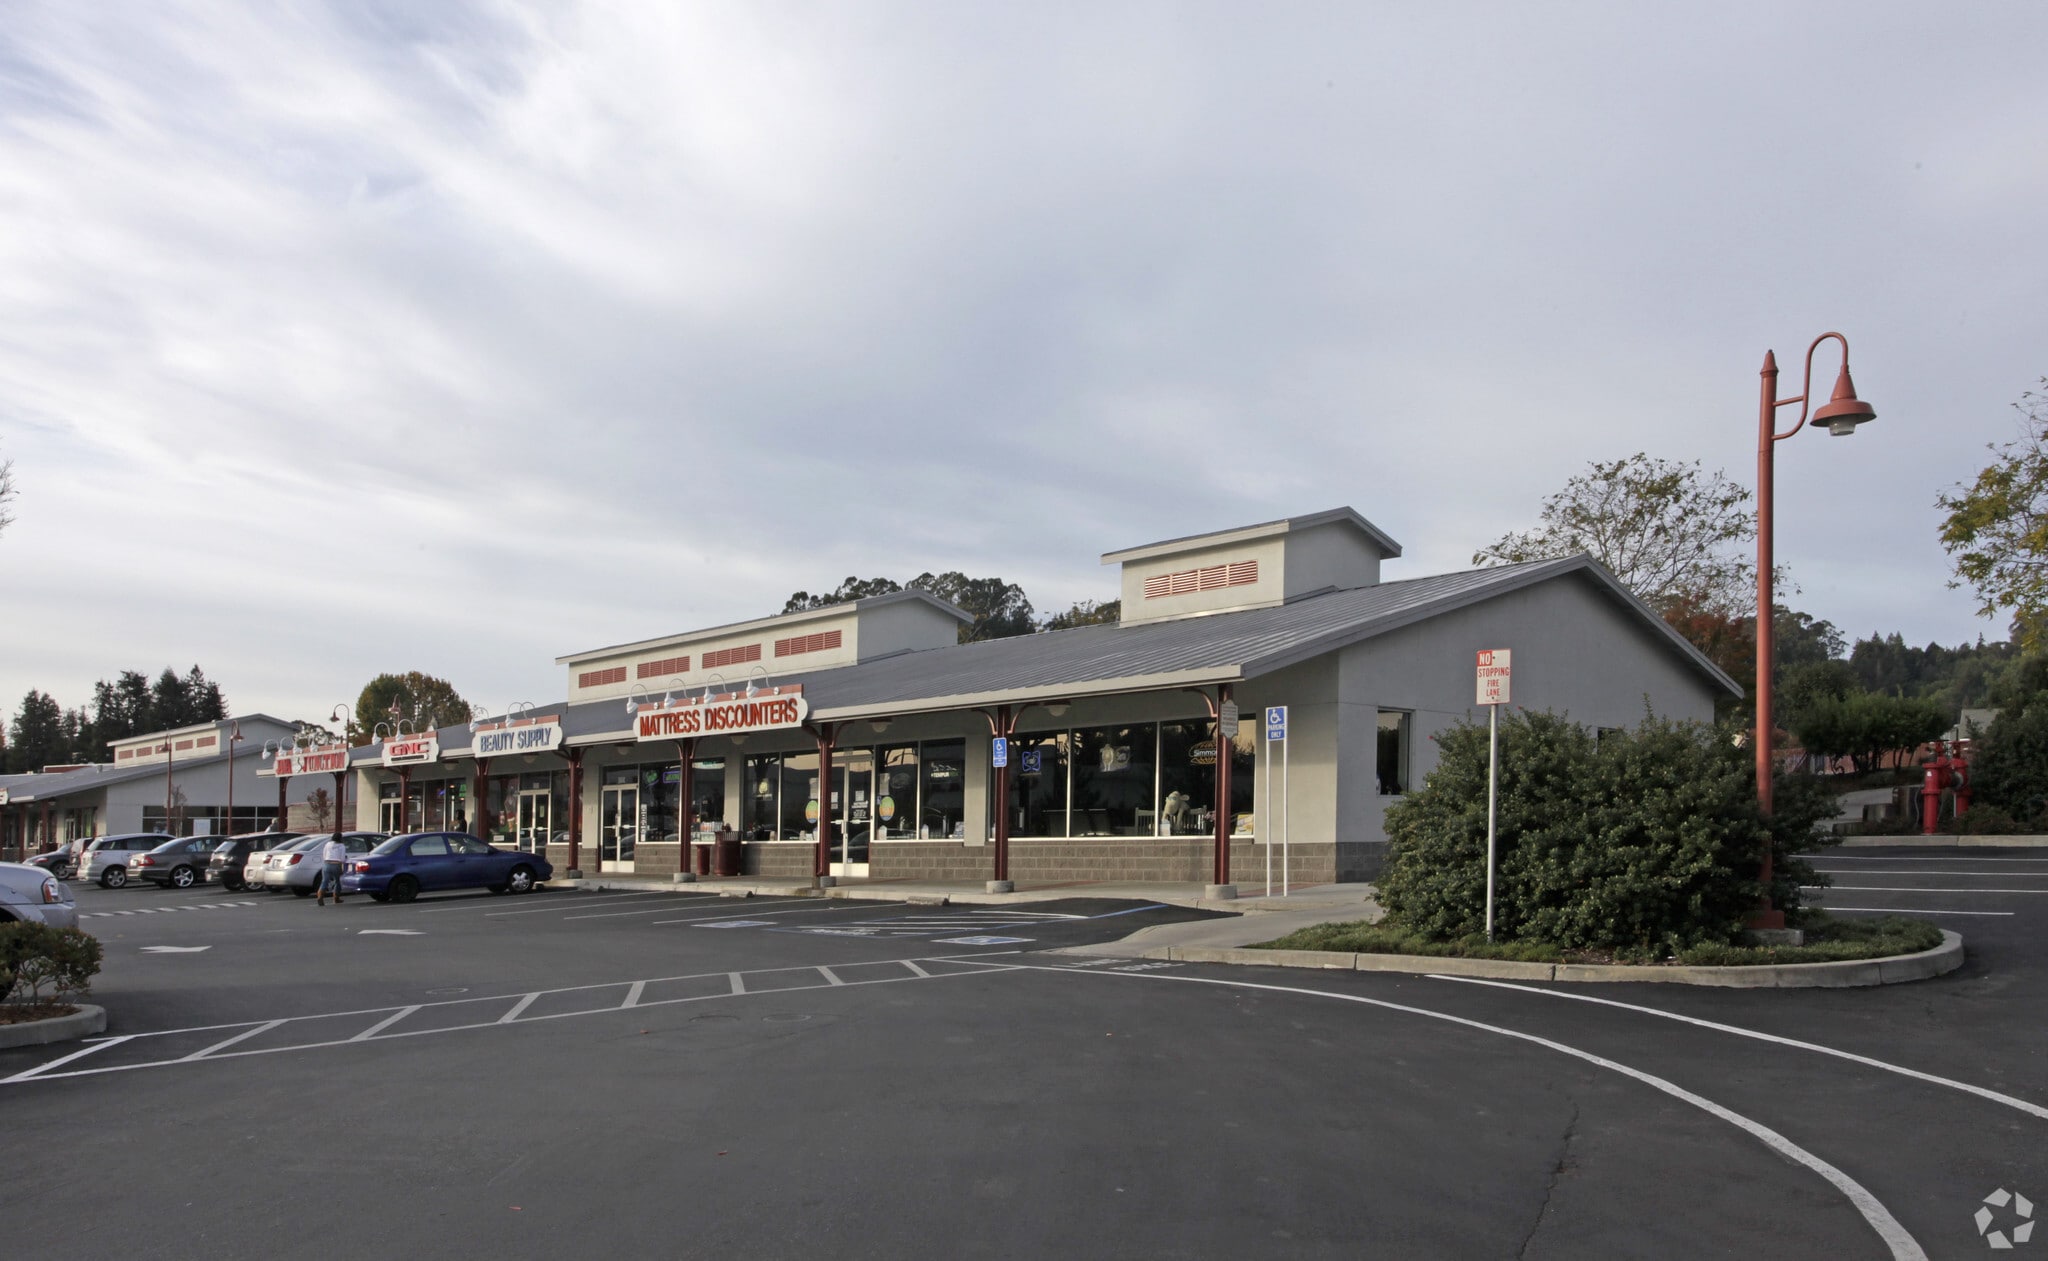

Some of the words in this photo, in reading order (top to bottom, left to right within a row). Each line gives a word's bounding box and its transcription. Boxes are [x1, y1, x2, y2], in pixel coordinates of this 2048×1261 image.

[1479, 653, 1491, 666] NO
[1478, 667, 1510, 678] STOPPING
[1487, 679, 1500, 687] FIRE
[1486, 688, 1500, 697] LANE
[639, 709, 700, 737] MATTRESS
[704, 697, 798, 731] DISCOUNTERS
[480, 732, 515, 752] BEAUTY
[517, 727, 552, 749] SUPPLY
[1270, 731, 1283, 739] ONLY
[389, 741, 430, 756] GNC
[302, 751, 346, 773] JUNCTION
